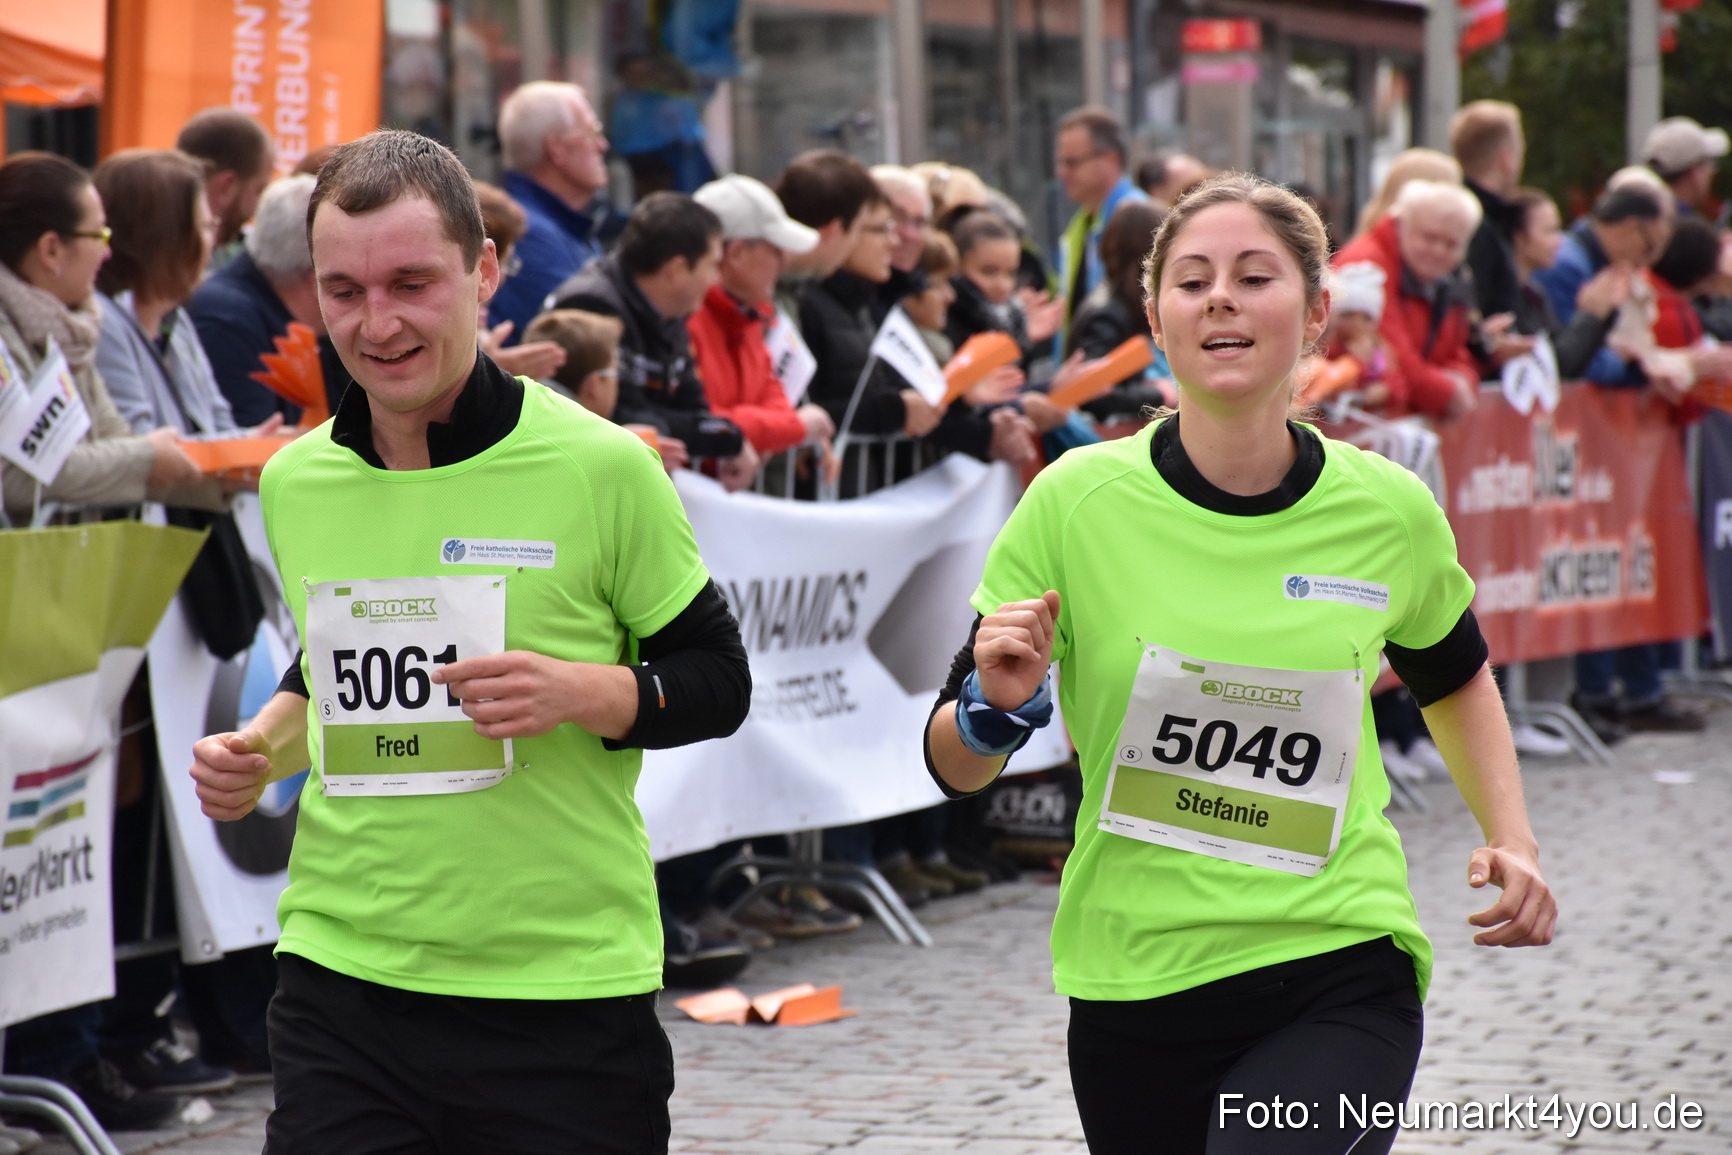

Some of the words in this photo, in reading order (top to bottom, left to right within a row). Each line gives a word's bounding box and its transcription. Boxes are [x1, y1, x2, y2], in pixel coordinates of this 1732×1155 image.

[231, 0, 266, 114] PRIN
[20, 396, 65, 458] swn
[519, 546, 554, 555] Volksschule
[1329, 582, 1360, 592] katholische
[1360, 586, 1388, 598] Volksschule
[369, 598, 437, 617] BOCK
[332, 643, 461, 712] 5061
[1221, 697, 1246, 706] inspired
[1274, 705, 1302, 713] concepts
[1223, 682, 1303, 707] BOCK
[376, 734, 420, 758] Fred
[1126, 750, 1136, 760] S
[1152, 713, 1322, 787] 5049
[1175, 788, 1270, 828] Stefanie
